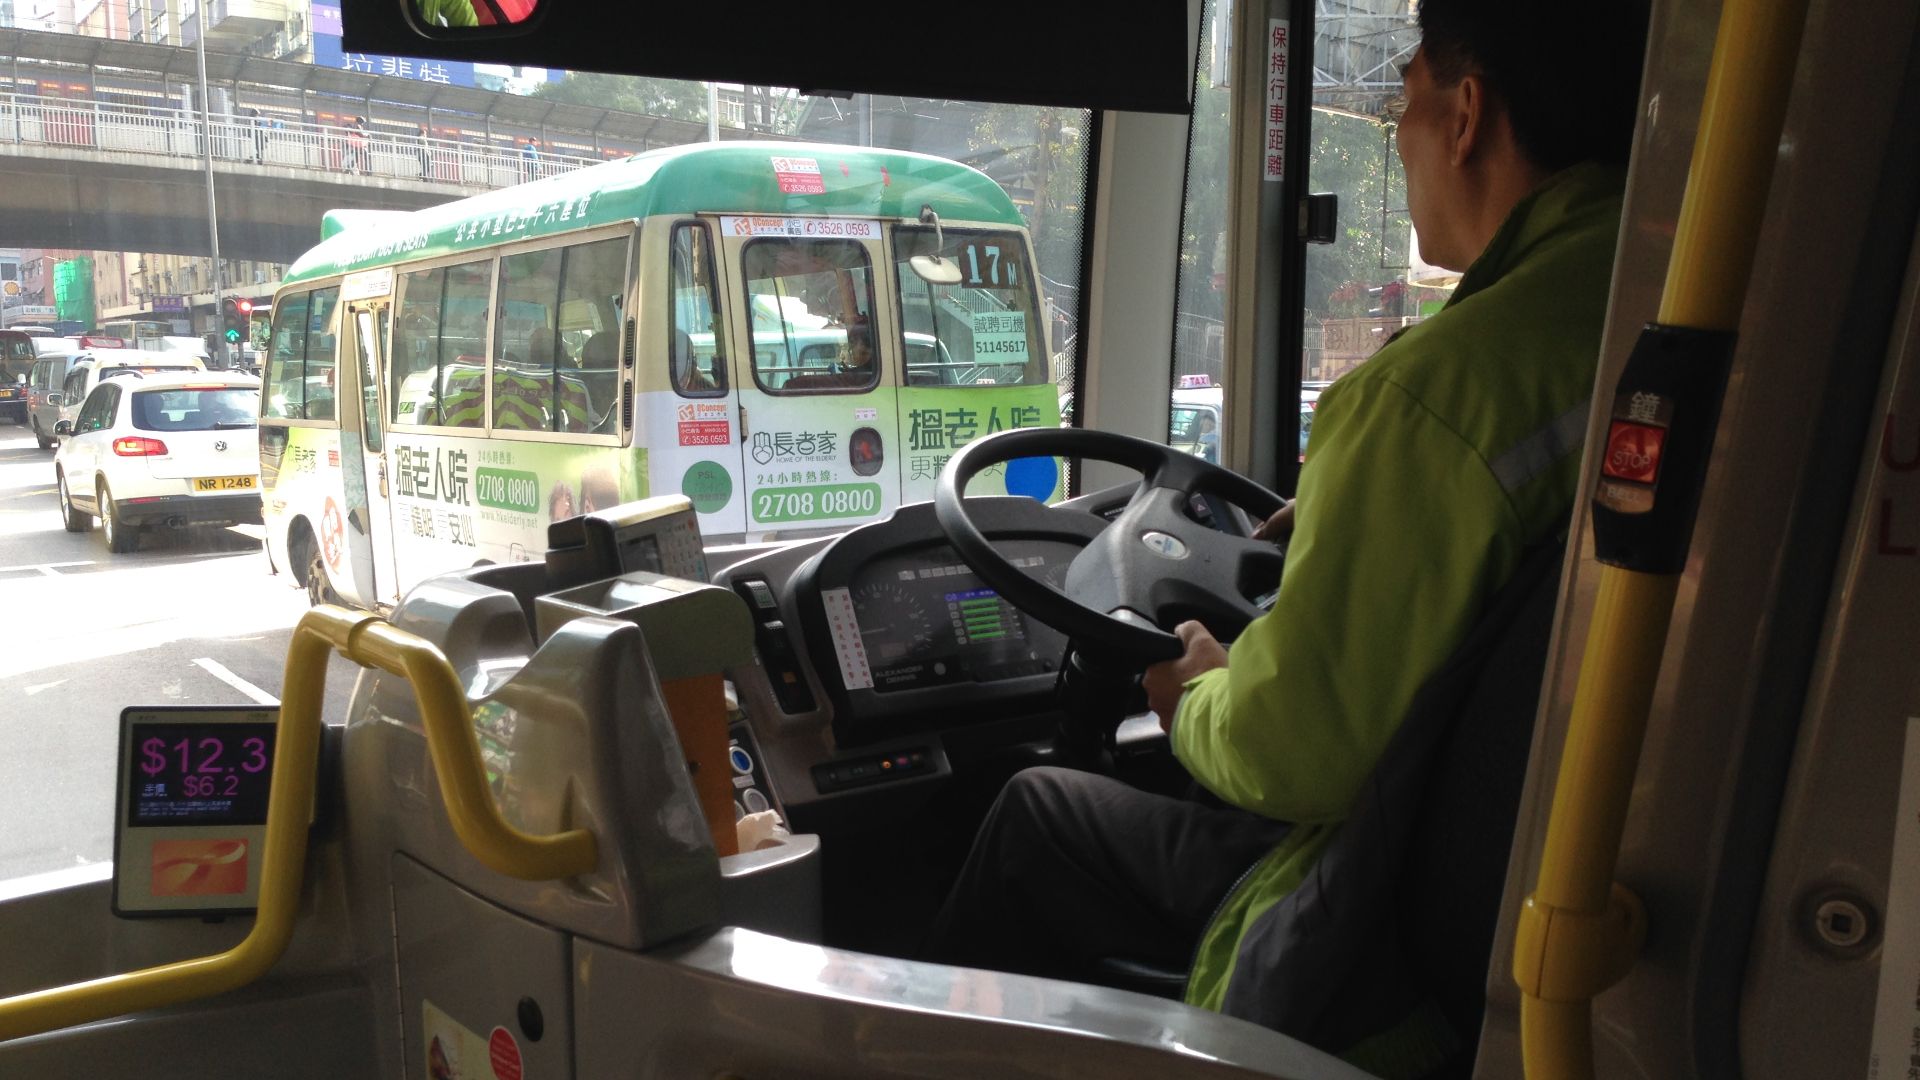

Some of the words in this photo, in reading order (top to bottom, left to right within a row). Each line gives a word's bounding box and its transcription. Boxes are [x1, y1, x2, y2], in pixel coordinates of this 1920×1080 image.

[1267, 26, 1288, 176] 保持行車距離
[818, 222, 843, 235] 3526
[846, 223, 870, 235] 0593
[974, 315, 1026, 334] 誠聘司機
[975, 341, 1027, 354] 51145617
[1190, 376, 1209, 385] TAXI
[1628, 391, 1660, 423] 鐘
[692, 435, 709, 444] 3526
[711, 434, 727, 444] 0593
[773, 430, 838, 456] 長者家
[1612, 450, 1652, 470] STOP
[199, 479, 217, 490] NR
[222, 477, 252, 488] 1248
[479, 474, 505, 503] 2708
[508, 478, 536, 508] 0800
[758, 492, 815, 518] 2708
[821, 489, 875, 514] 0800
[875, 664, 924, 678] ALEXANDER
[141, 737, 267, 776] $12.3
[183, 775, 239, 797] $6.2
